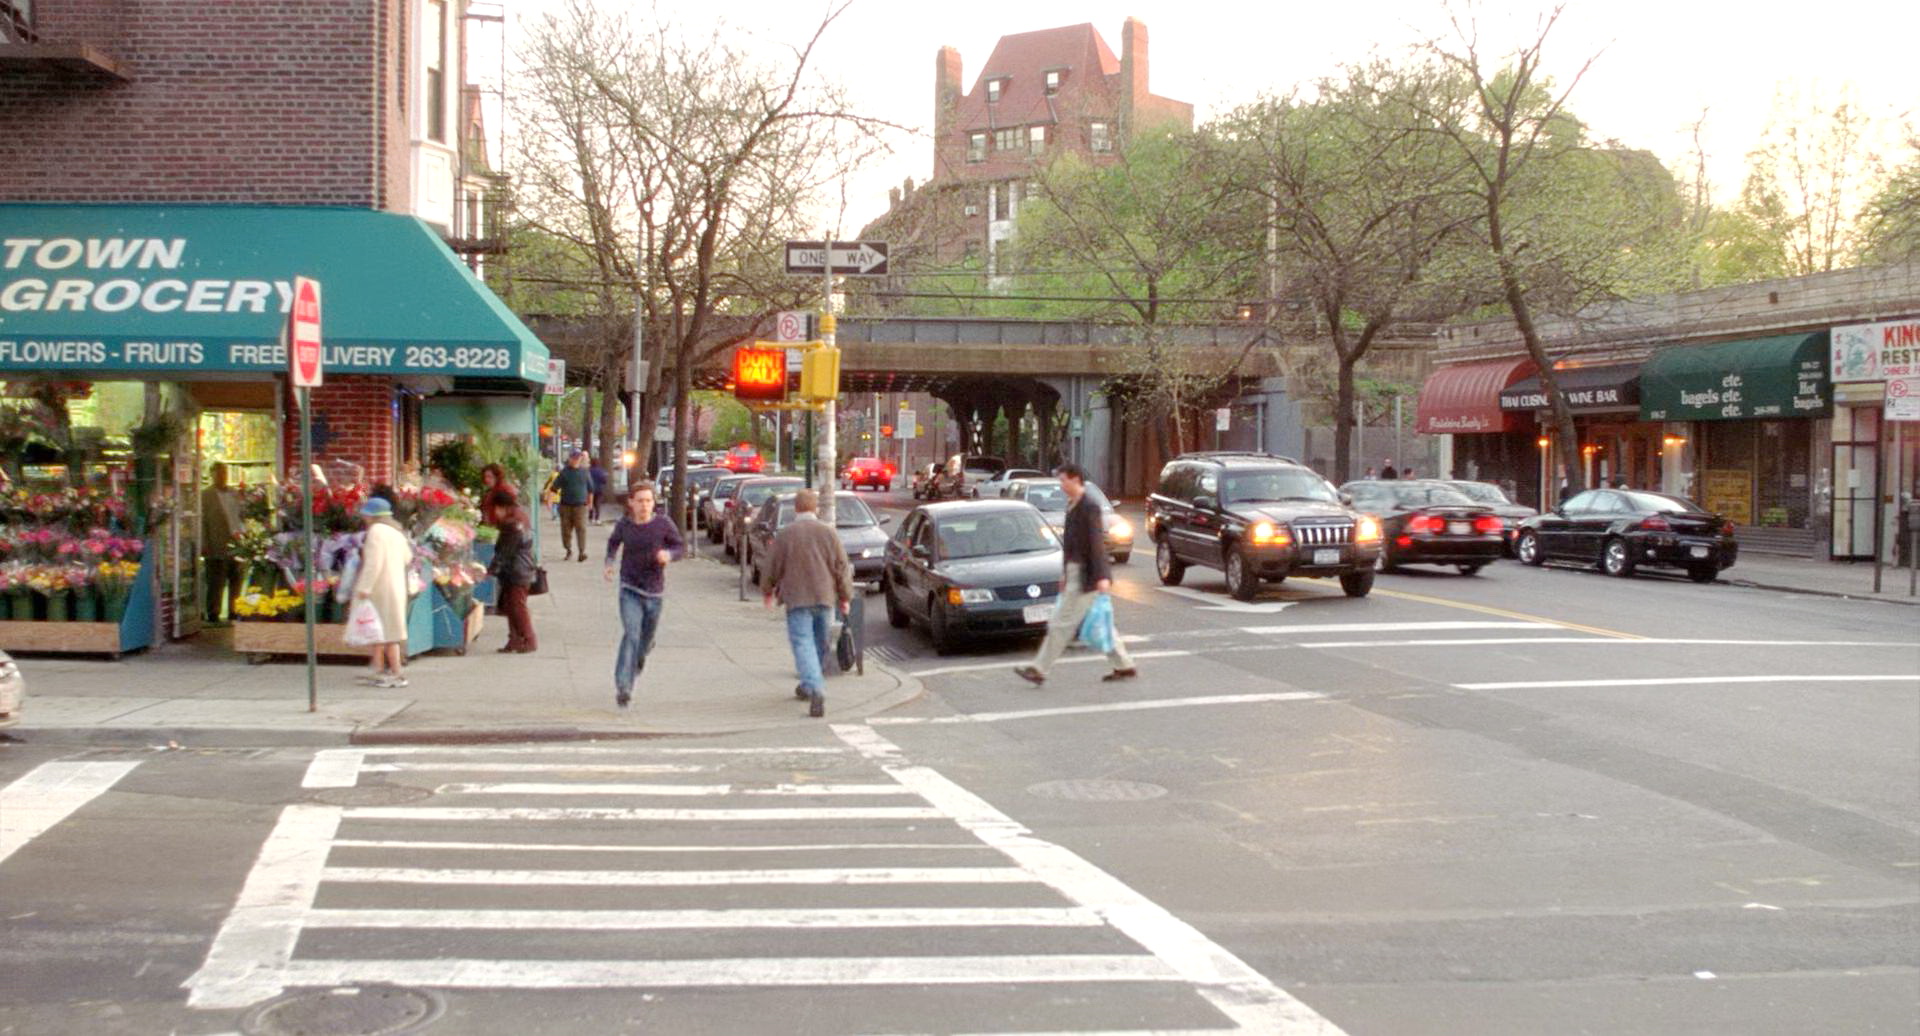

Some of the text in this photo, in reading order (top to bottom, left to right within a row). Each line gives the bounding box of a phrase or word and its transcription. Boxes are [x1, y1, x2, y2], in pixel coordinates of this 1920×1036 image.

[4, 238, 187, 269] TOWN
[799, 253, 876, 265] ONE WAY
[0, 279, 294, 313] GROCERY
[0, 341, 107, 363] FLOWERS
[125, 342, 204, 364] FRUITS
[230, 344, 286, 364] FREE
[321, 345, 395, 366] LIVERY
[405, 346, 511, 369] 263-8228
[740, 367, 783, 385] WALK
[1722, 374, 1743, 387] etc.
[1799, 381, 1816, 395] Hot
[1520, 393, 1550, 407] CUISIN
[1596, 389, 1618, 403] BAR
[1681, 388, 1742, 409] bagels etc.
[1721, 404, 1742, 417] etc.
